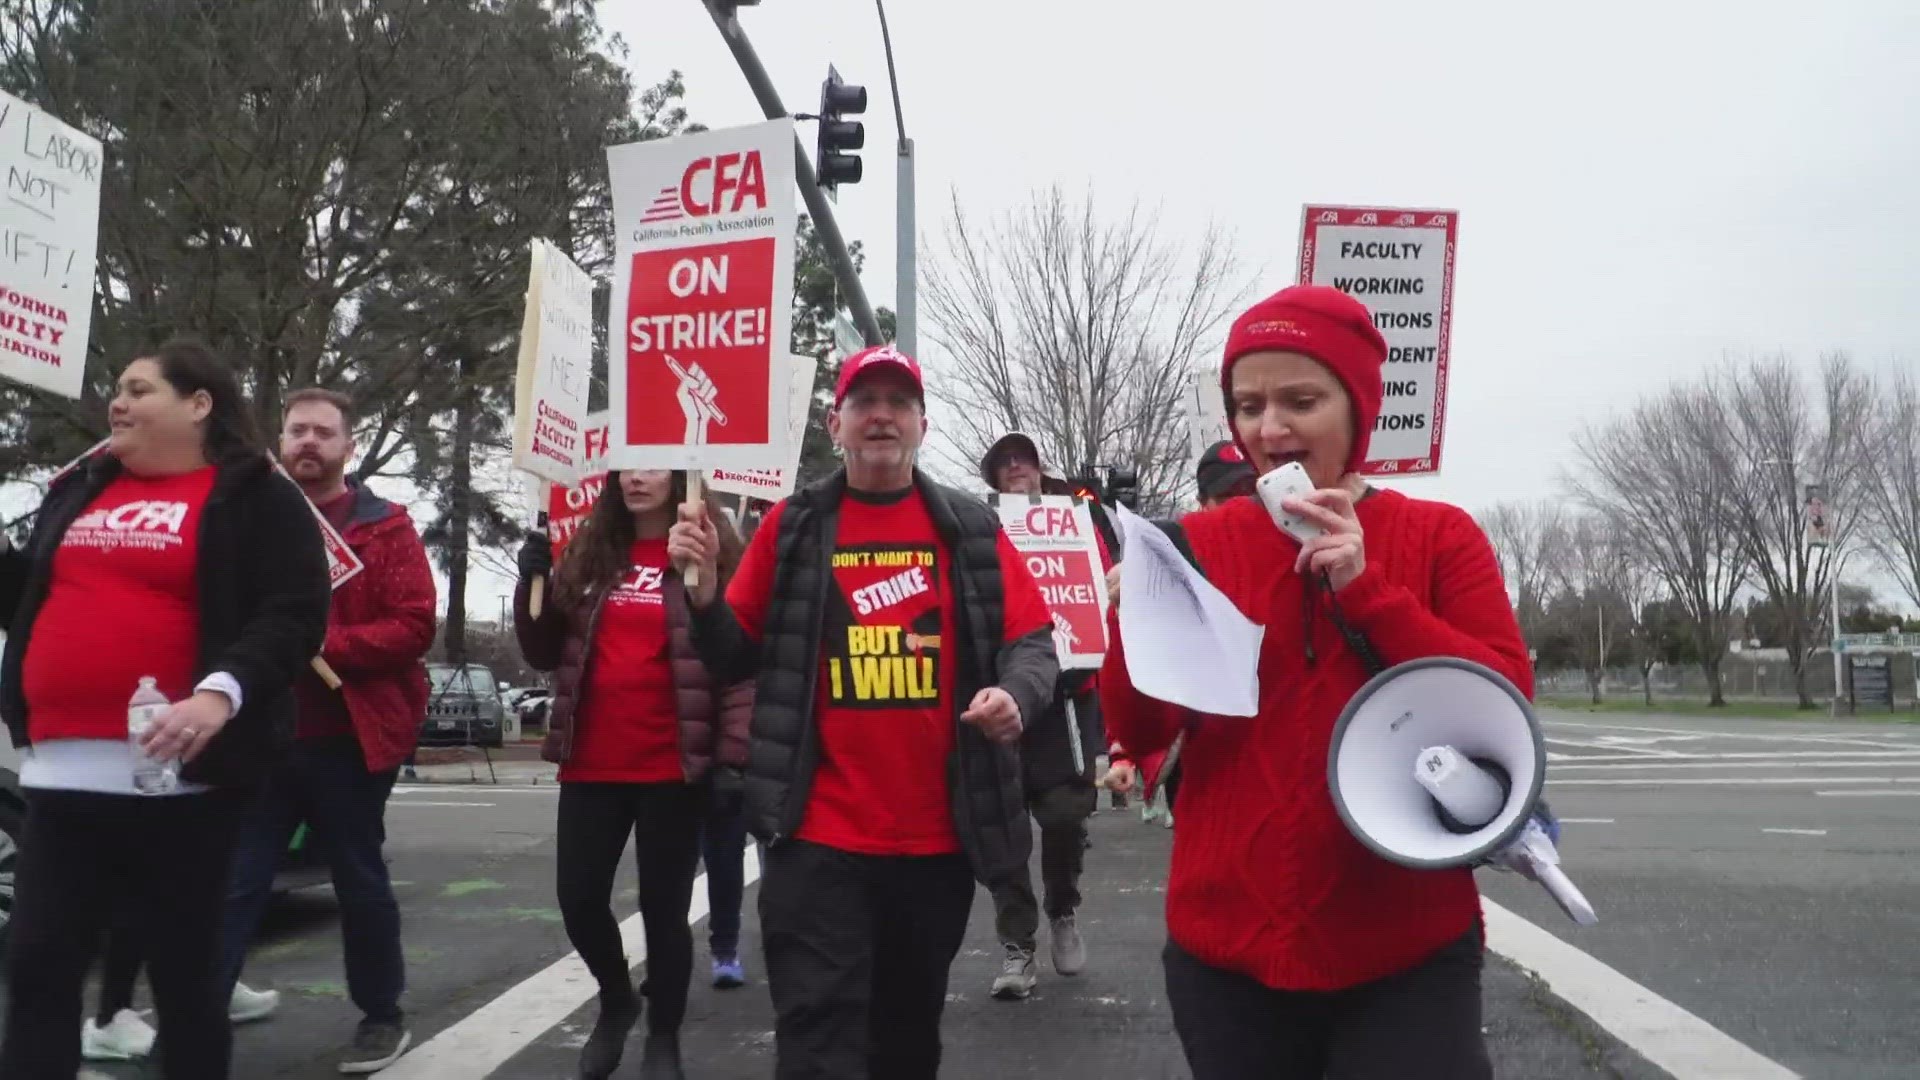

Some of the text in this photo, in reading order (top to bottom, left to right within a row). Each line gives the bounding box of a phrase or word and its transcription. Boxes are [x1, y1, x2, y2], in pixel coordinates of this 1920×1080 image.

[24, 111, 99, 181] LABOR
[8, 165, 71, 209] NOT
[680, 149, 767, 218] CFA
[633, 215, 775, 243] California Faculty Association
[1341, 242, 1422, 259] FACULTY
[668, 255, 729, 298] ON
[1334, 277, 1424, 294] WORKING
[630, 306, 766, 353] STRIKE!
[1369, 312, 1433, 329] ITIONS
[0, 335, 61, 368] IATION
[1382, 380, 1418, 397] ING
[535, 418, 576, 450] FACULTY
[566, 480, 602, 511] ON
[106, 499, 188, 533] CFA
[1026, 506, 1079, 538] CFA
[832, 551, 934, 568] DON'T WANT TO
[1027, 555, 1066, 578] ON
[852, 566, 929, 616] STRIKE
[848, 625, 902, 656] BUT
[830, 656, 937, 700] I WILL
